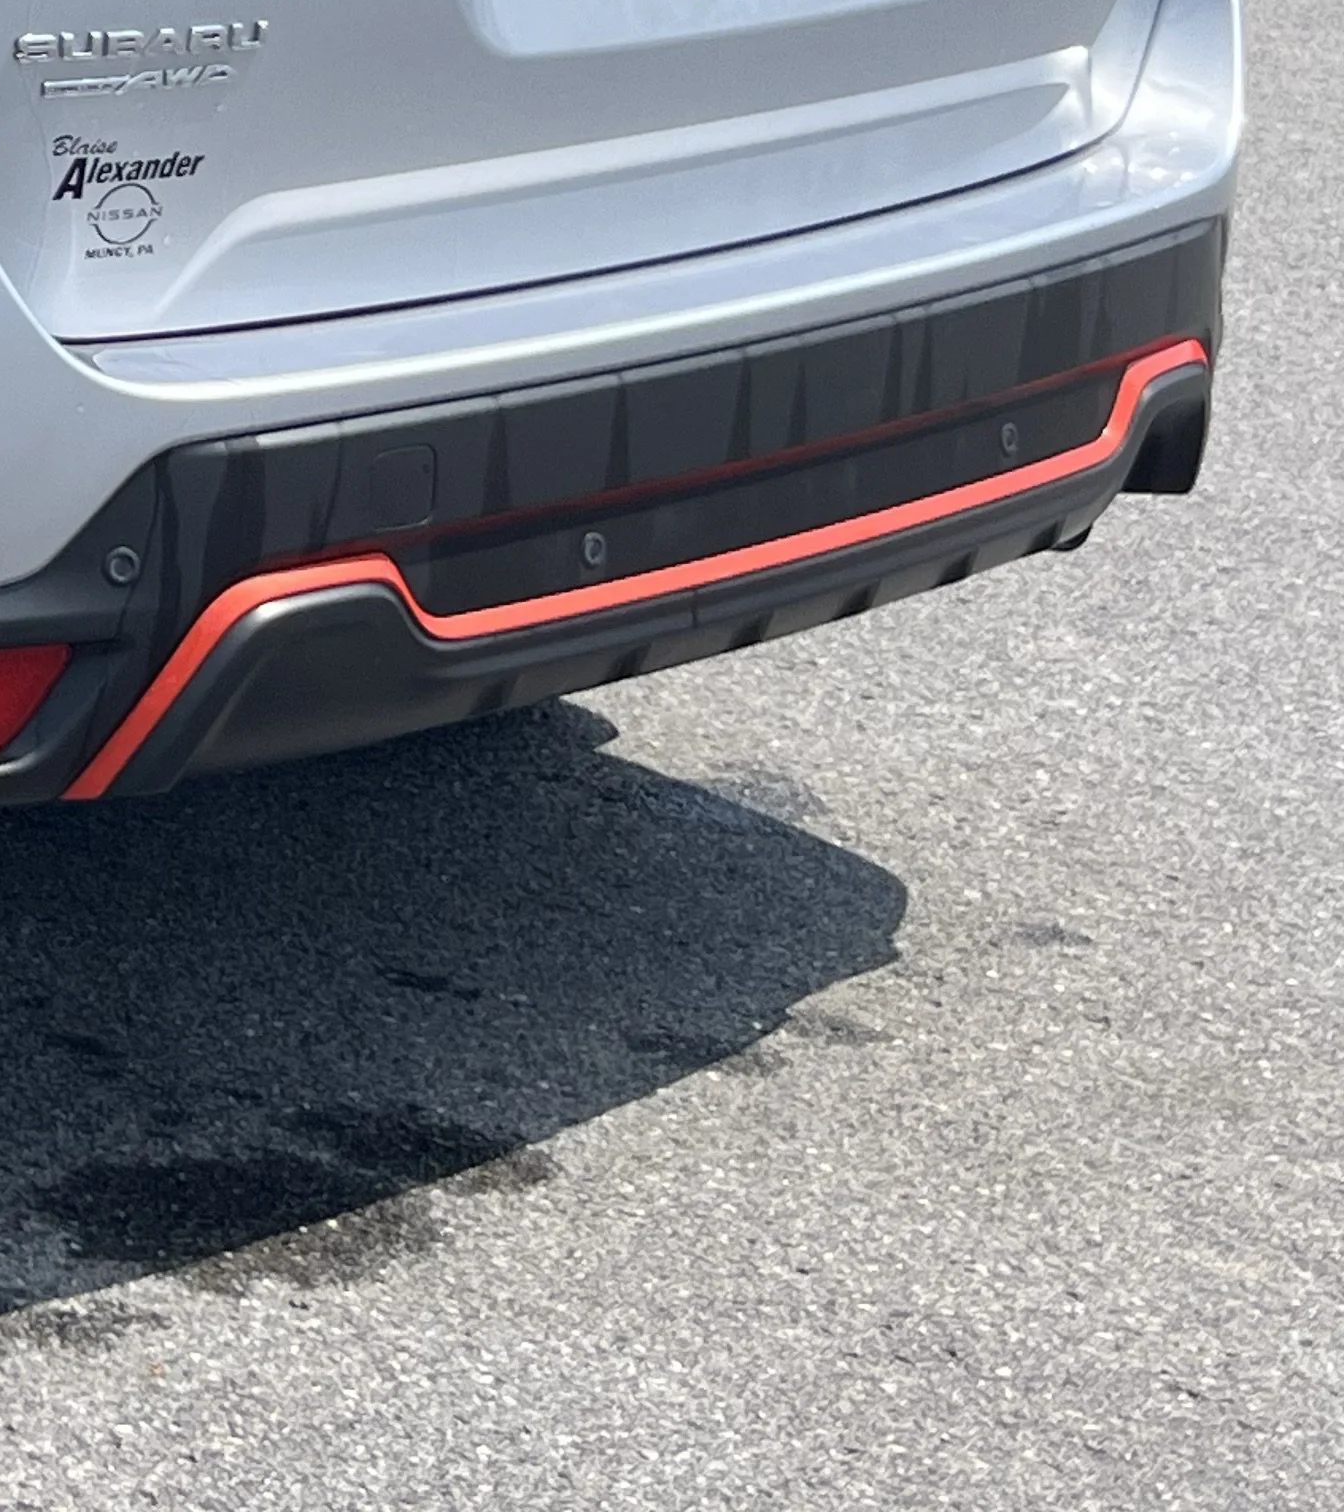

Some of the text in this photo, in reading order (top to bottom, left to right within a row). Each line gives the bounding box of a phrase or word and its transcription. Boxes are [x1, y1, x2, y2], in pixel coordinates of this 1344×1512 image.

[14, 20, 269, 63] SUBARU
[114, 64, 237, 95] AWD
[52, 134, 118, 157] Blaise
[52, 151, 205, 201] Alexander
[86, 206, 163, 222] NISSAN
[84, 244, 154, 260] MUNCY, PA
